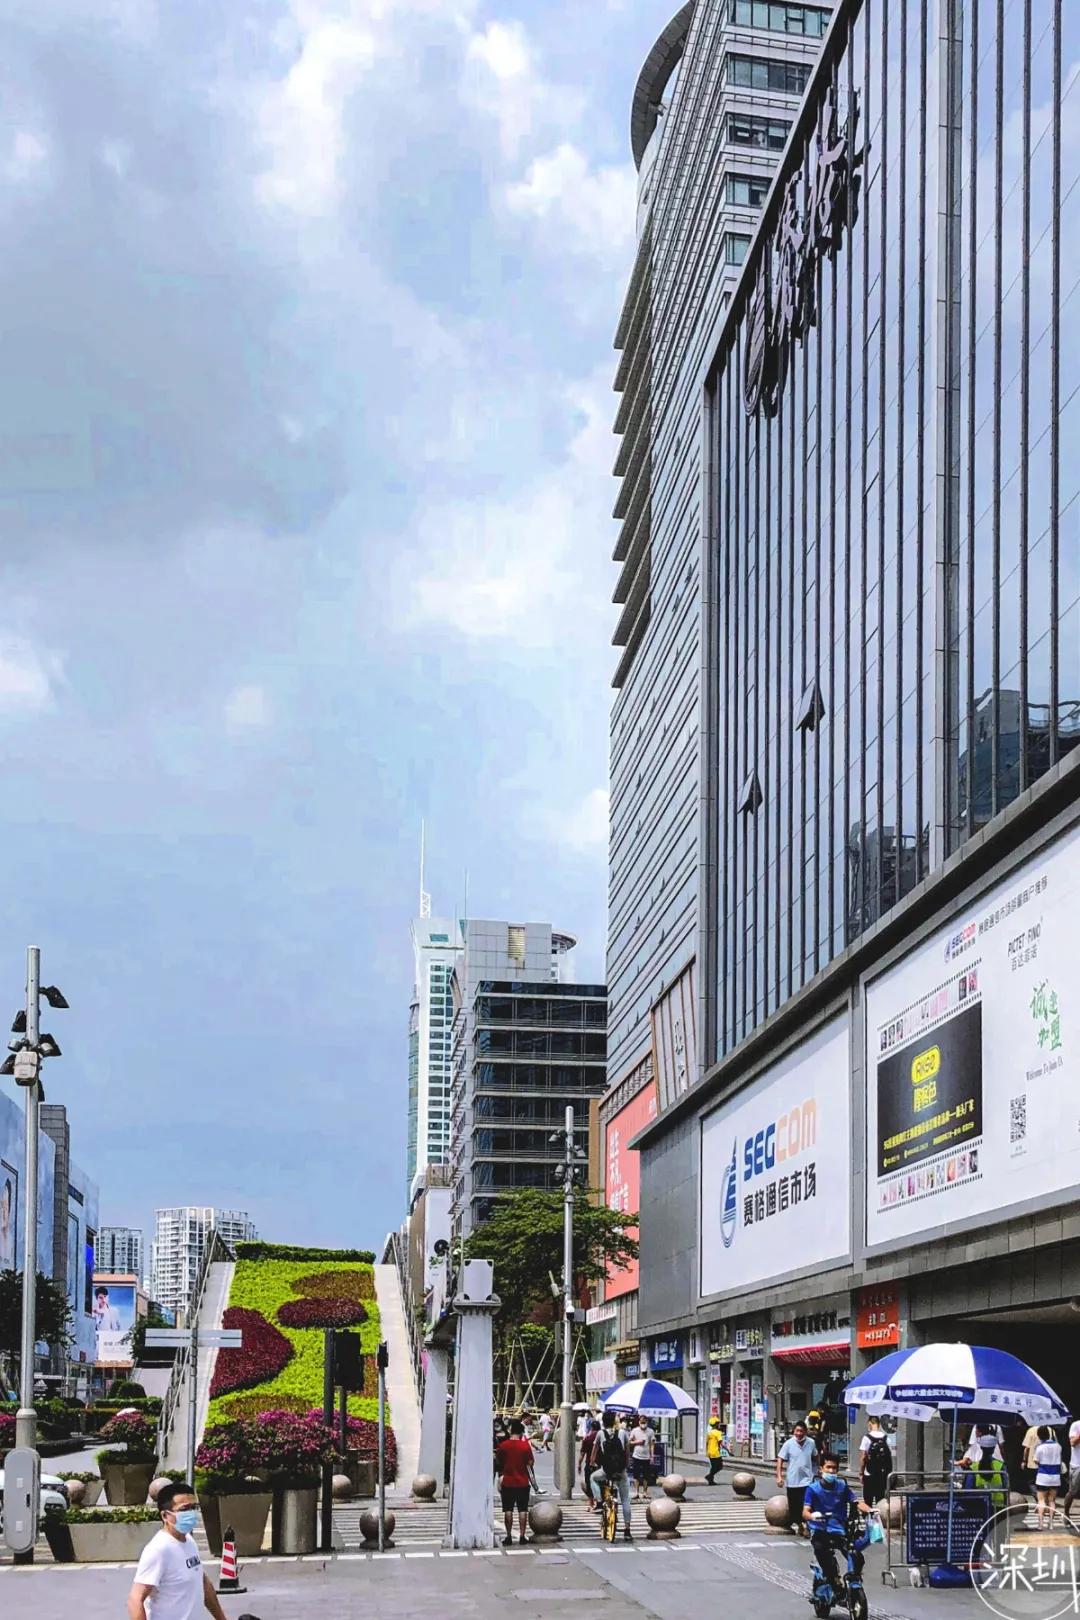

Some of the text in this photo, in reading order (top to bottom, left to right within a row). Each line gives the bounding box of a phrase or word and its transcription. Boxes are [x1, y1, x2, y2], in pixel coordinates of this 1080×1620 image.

[744, 1098, 817, 1182] SEGCOM
[743, 1161, 817, 1227] 赛格通信市场
[989, 1394, 1033, 1408] 安全出行
